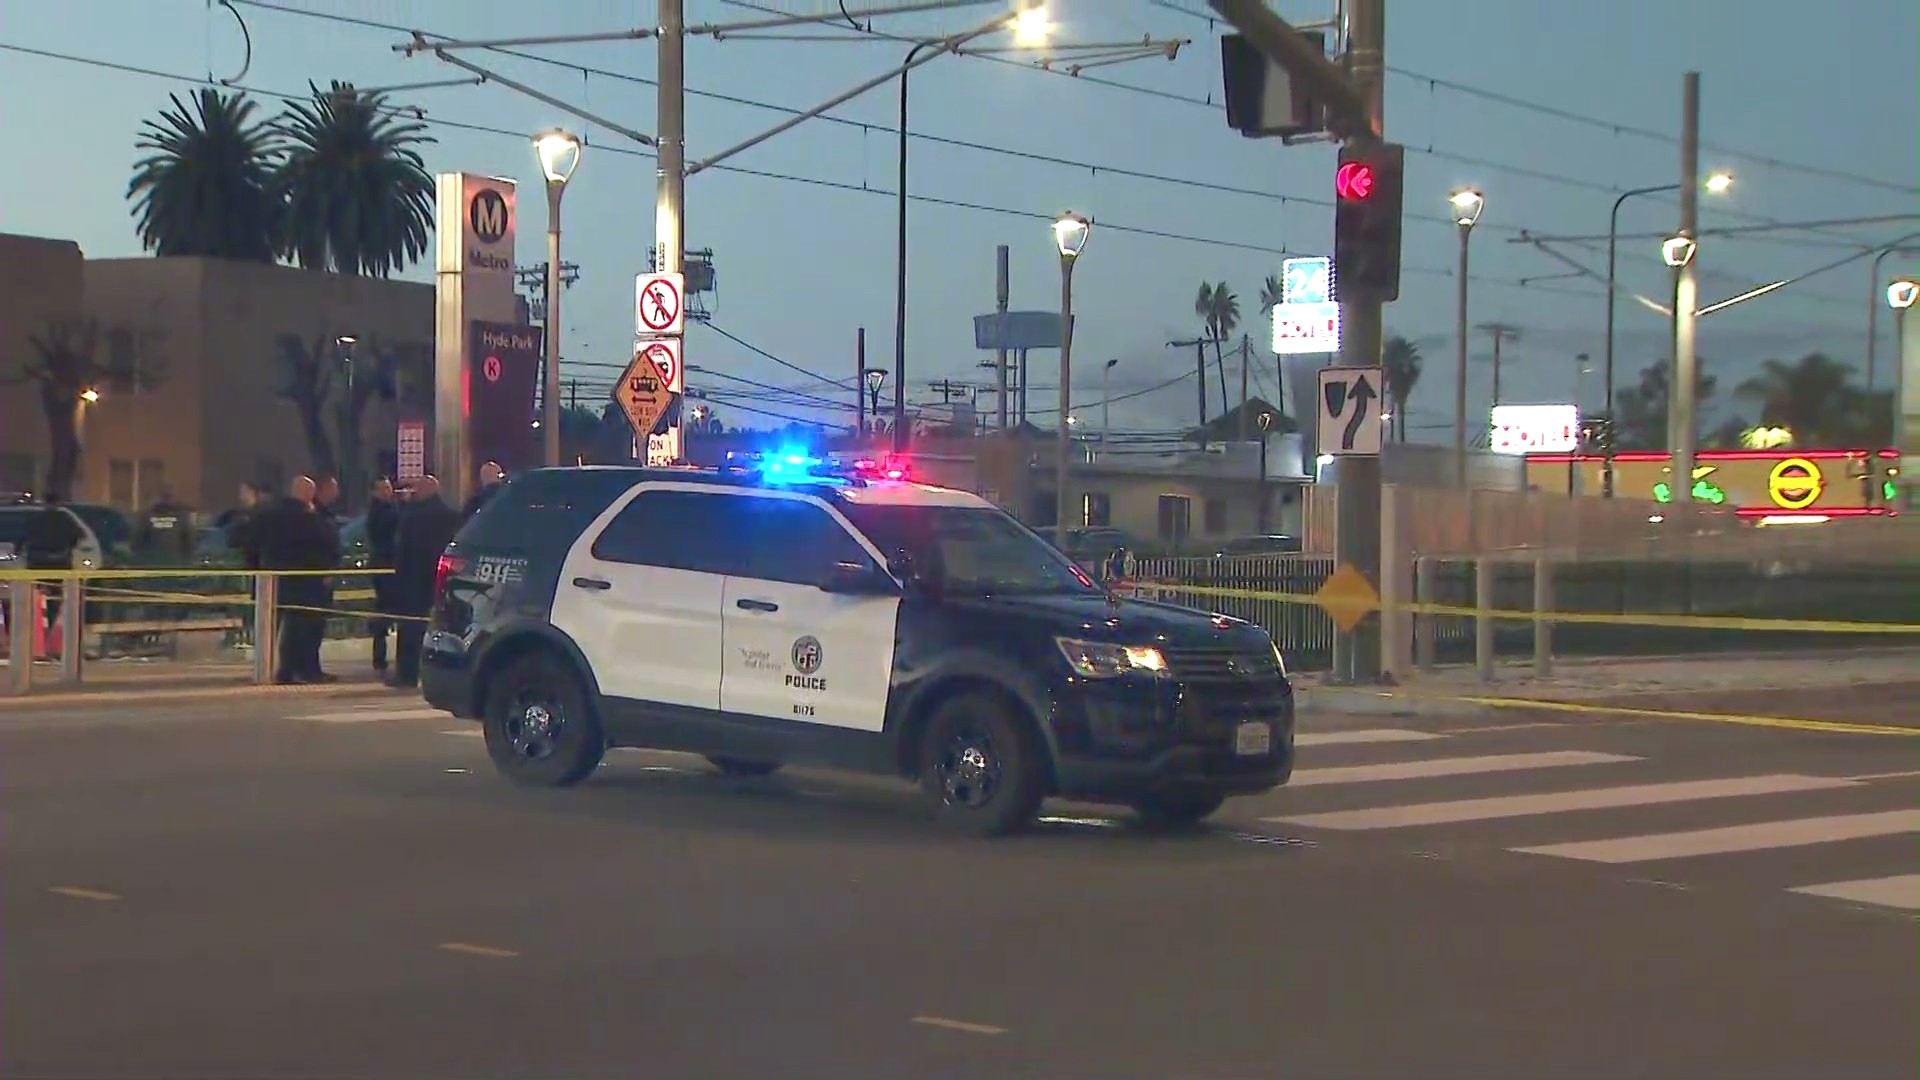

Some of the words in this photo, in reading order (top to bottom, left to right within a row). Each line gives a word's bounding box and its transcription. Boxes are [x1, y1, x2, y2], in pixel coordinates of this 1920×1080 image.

[477, 197, 503, 235] M
[469, 249, 509, 270] Metro
[1287, 267, 1324, 299] 24
[483, 331, 509, 349] Hyde
[511, 335, 533, 349] Park
[487, 361, 497, 376] K
[480, 563, 510, 584] 911
[785, 675, 827, 691] POLICE
